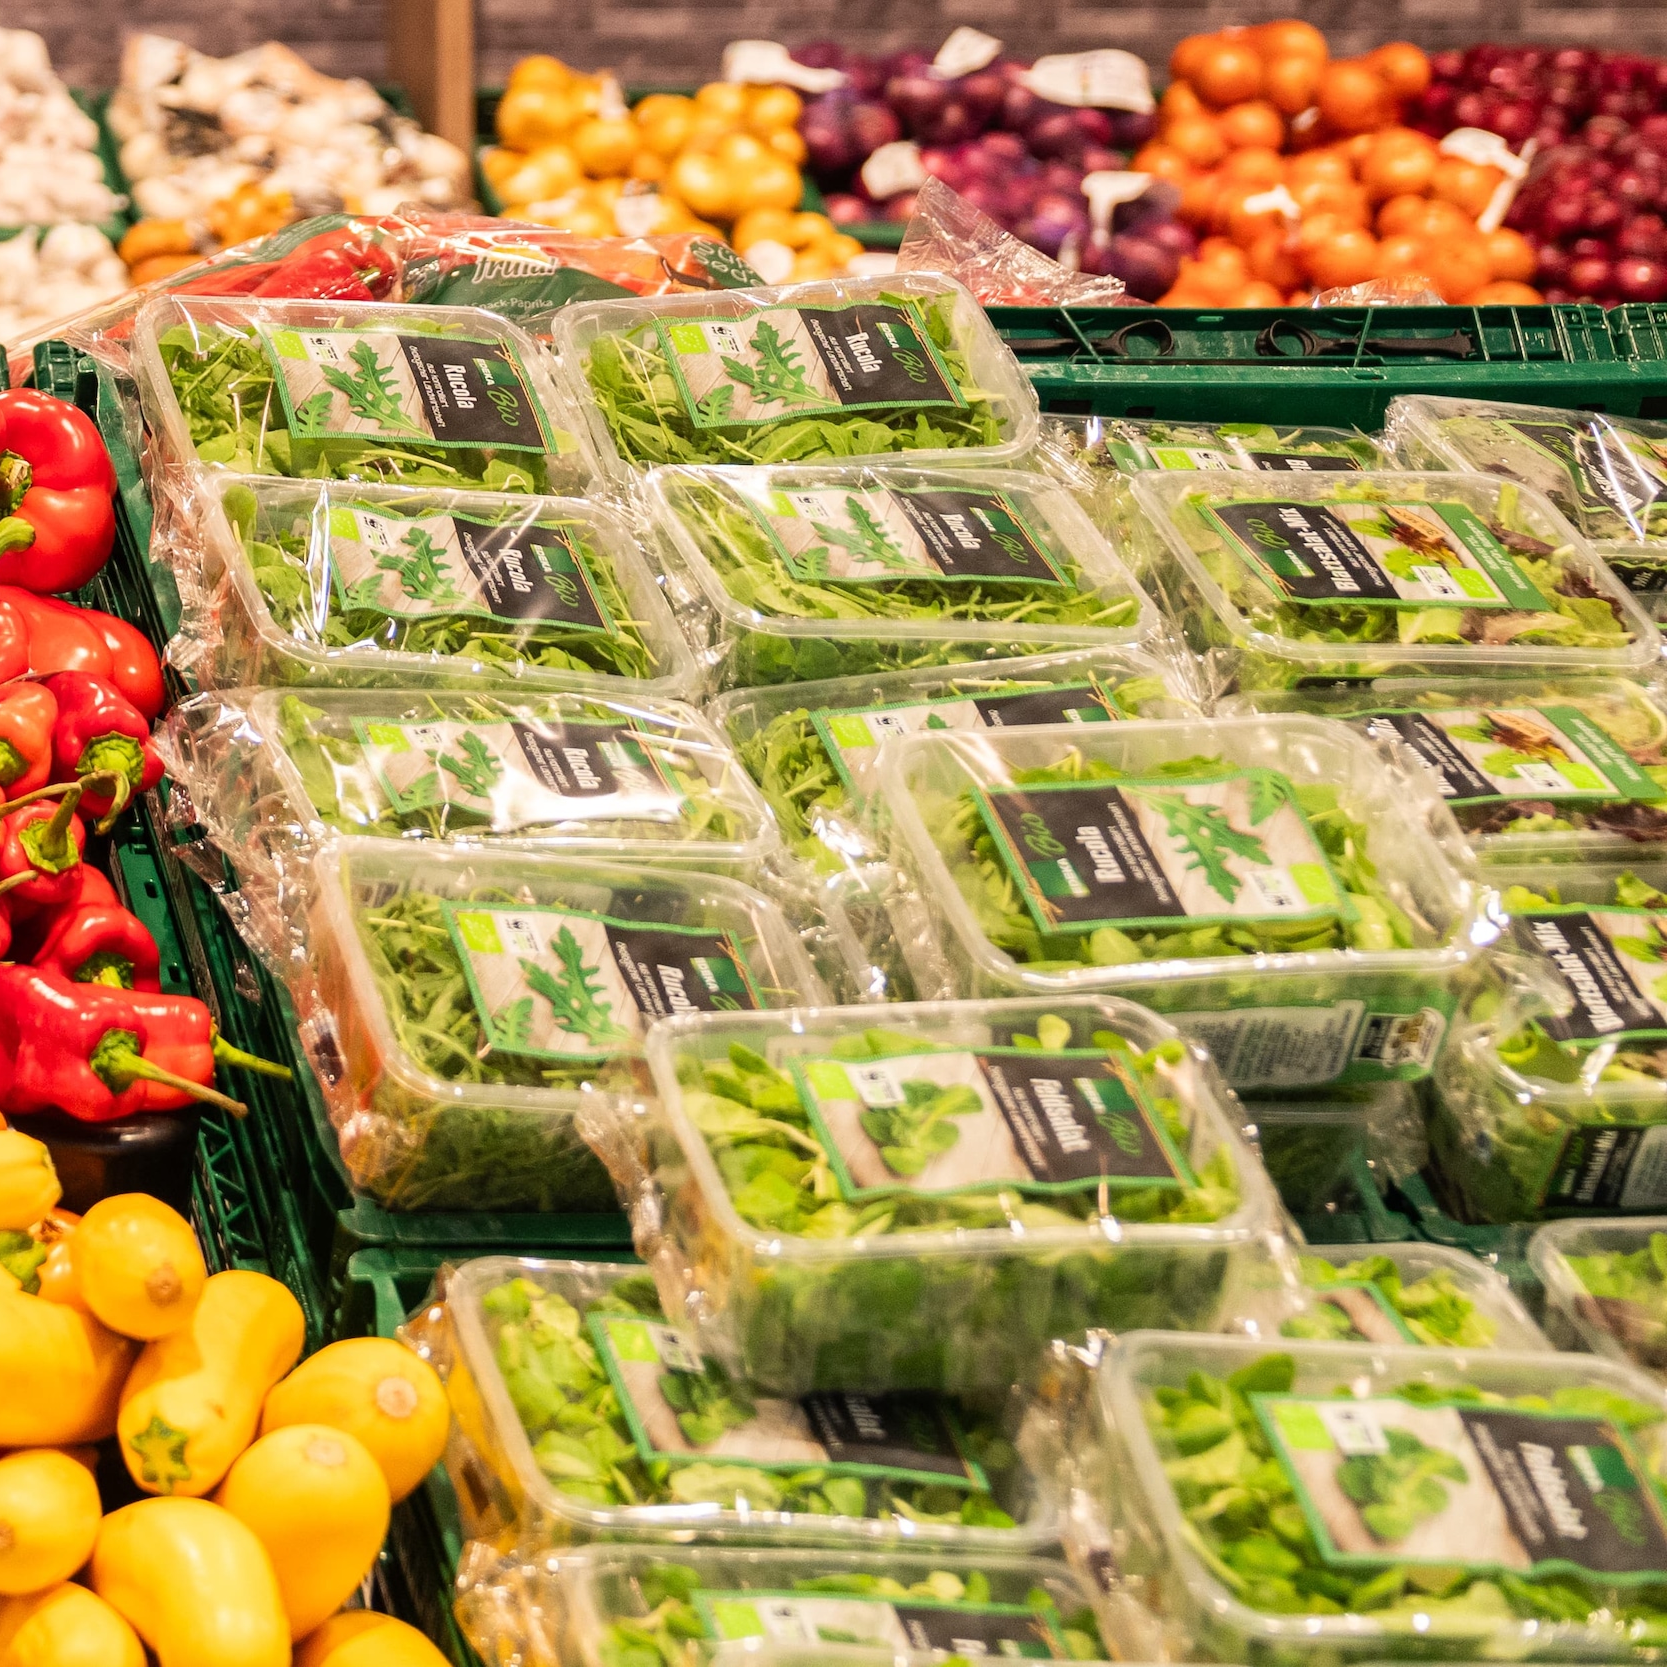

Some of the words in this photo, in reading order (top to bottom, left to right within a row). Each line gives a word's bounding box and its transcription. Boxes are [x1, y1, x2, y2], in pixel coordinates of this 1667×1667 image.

[845, 332, 882, 373] Rucola
[881, 323, 900, 349] EDEKA
[892, 349, 928, 383] Bio
[443, 364, 477, 409] Rucola
[476, 358, 495, 386] EDEKA
[487, 386, 520, 426] Bio
[939, 514, 982, 550] Rucola
[990, 533, 1029, 564] Bio
[1246, 518, 1289, 549] Bio
[1278, 507, 1361, 591] Blattsalat-Mix
[498, 549, 534, 592] Rucola
[544, 572, 580, 608] Bio
[1020, 813, 1066, 857] Bio
[1075, 826, 1126, 882] Rucola
[657, 964, 700, 1012] Rucol
[1532, 922, 1625, 1032] Blattsalat-Mix
[1029, 1079, 1092, 1154] Feldsalat
